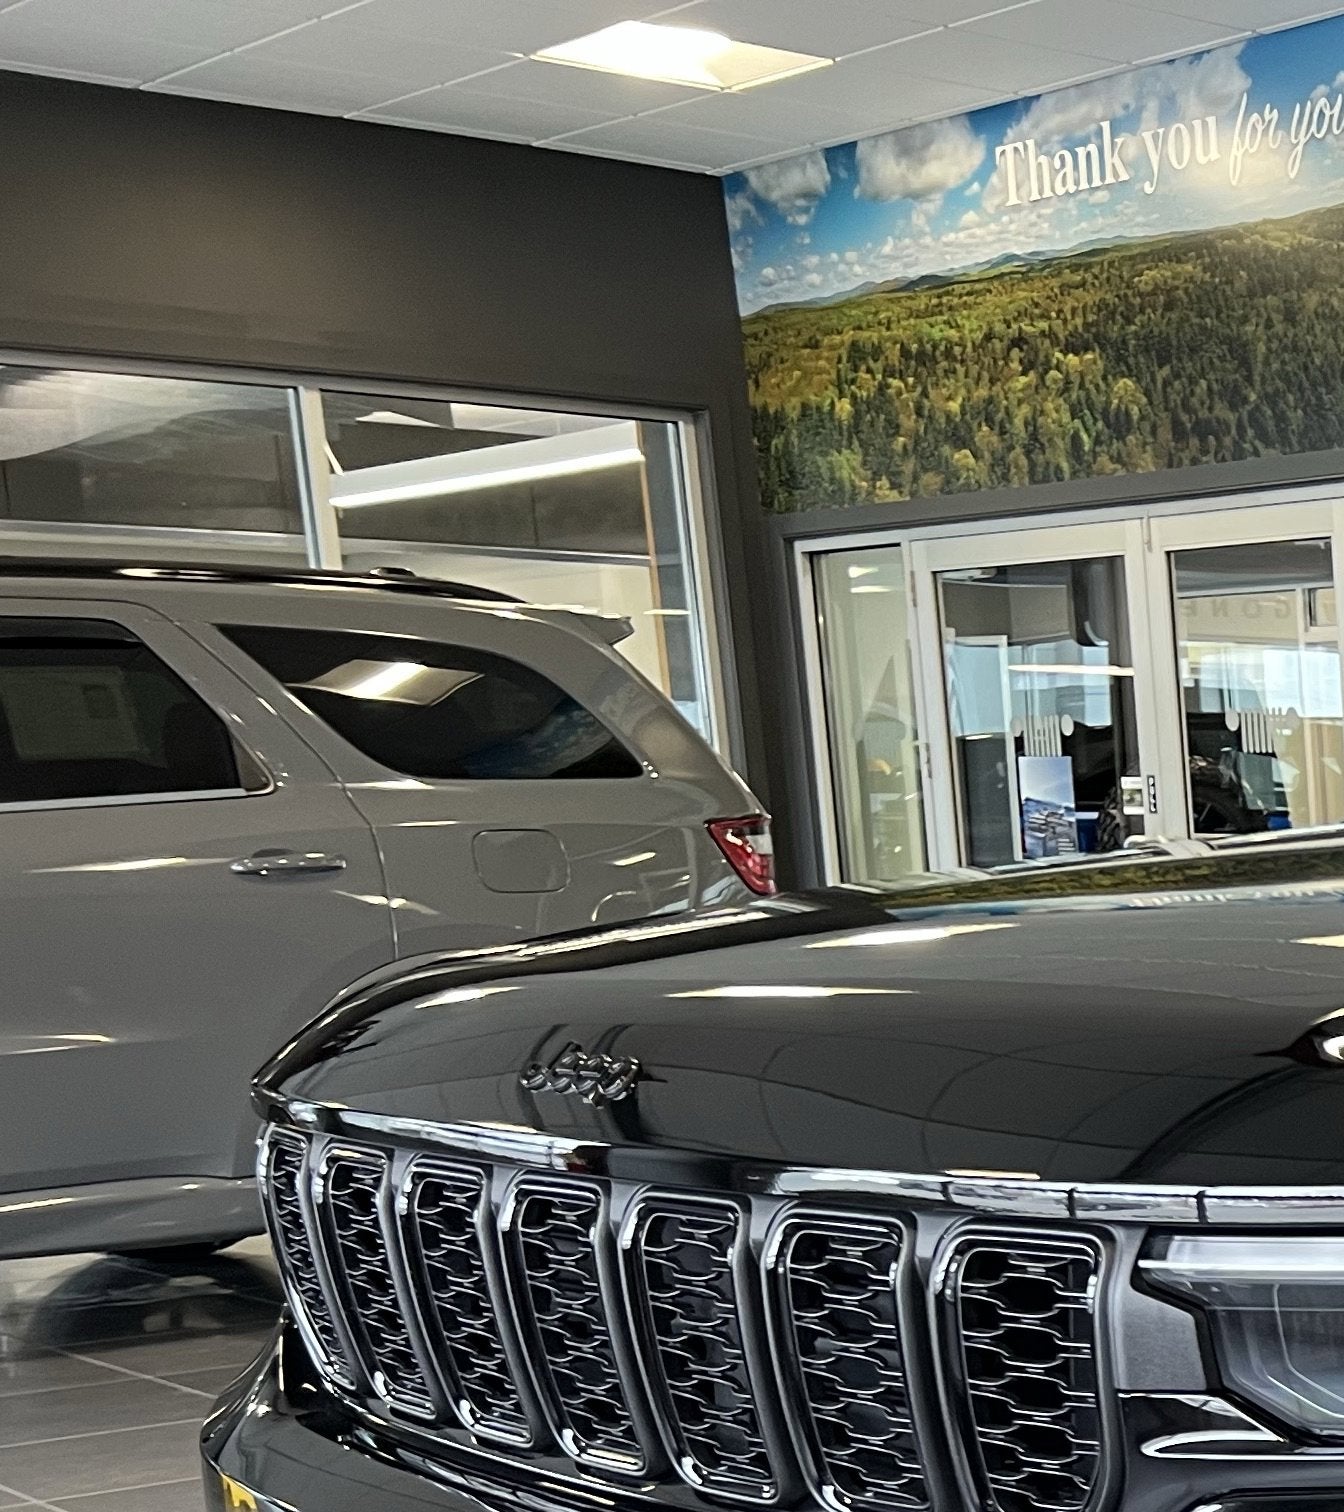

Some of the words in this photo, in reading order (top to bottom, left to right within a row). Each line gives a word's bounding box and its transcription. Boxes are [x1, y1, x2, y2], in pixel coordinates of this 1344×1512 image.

[995, 120, 1130, 207] Thank
[1142, 115, 1221, 194] you
[1228, 91, 1281, 186] for
